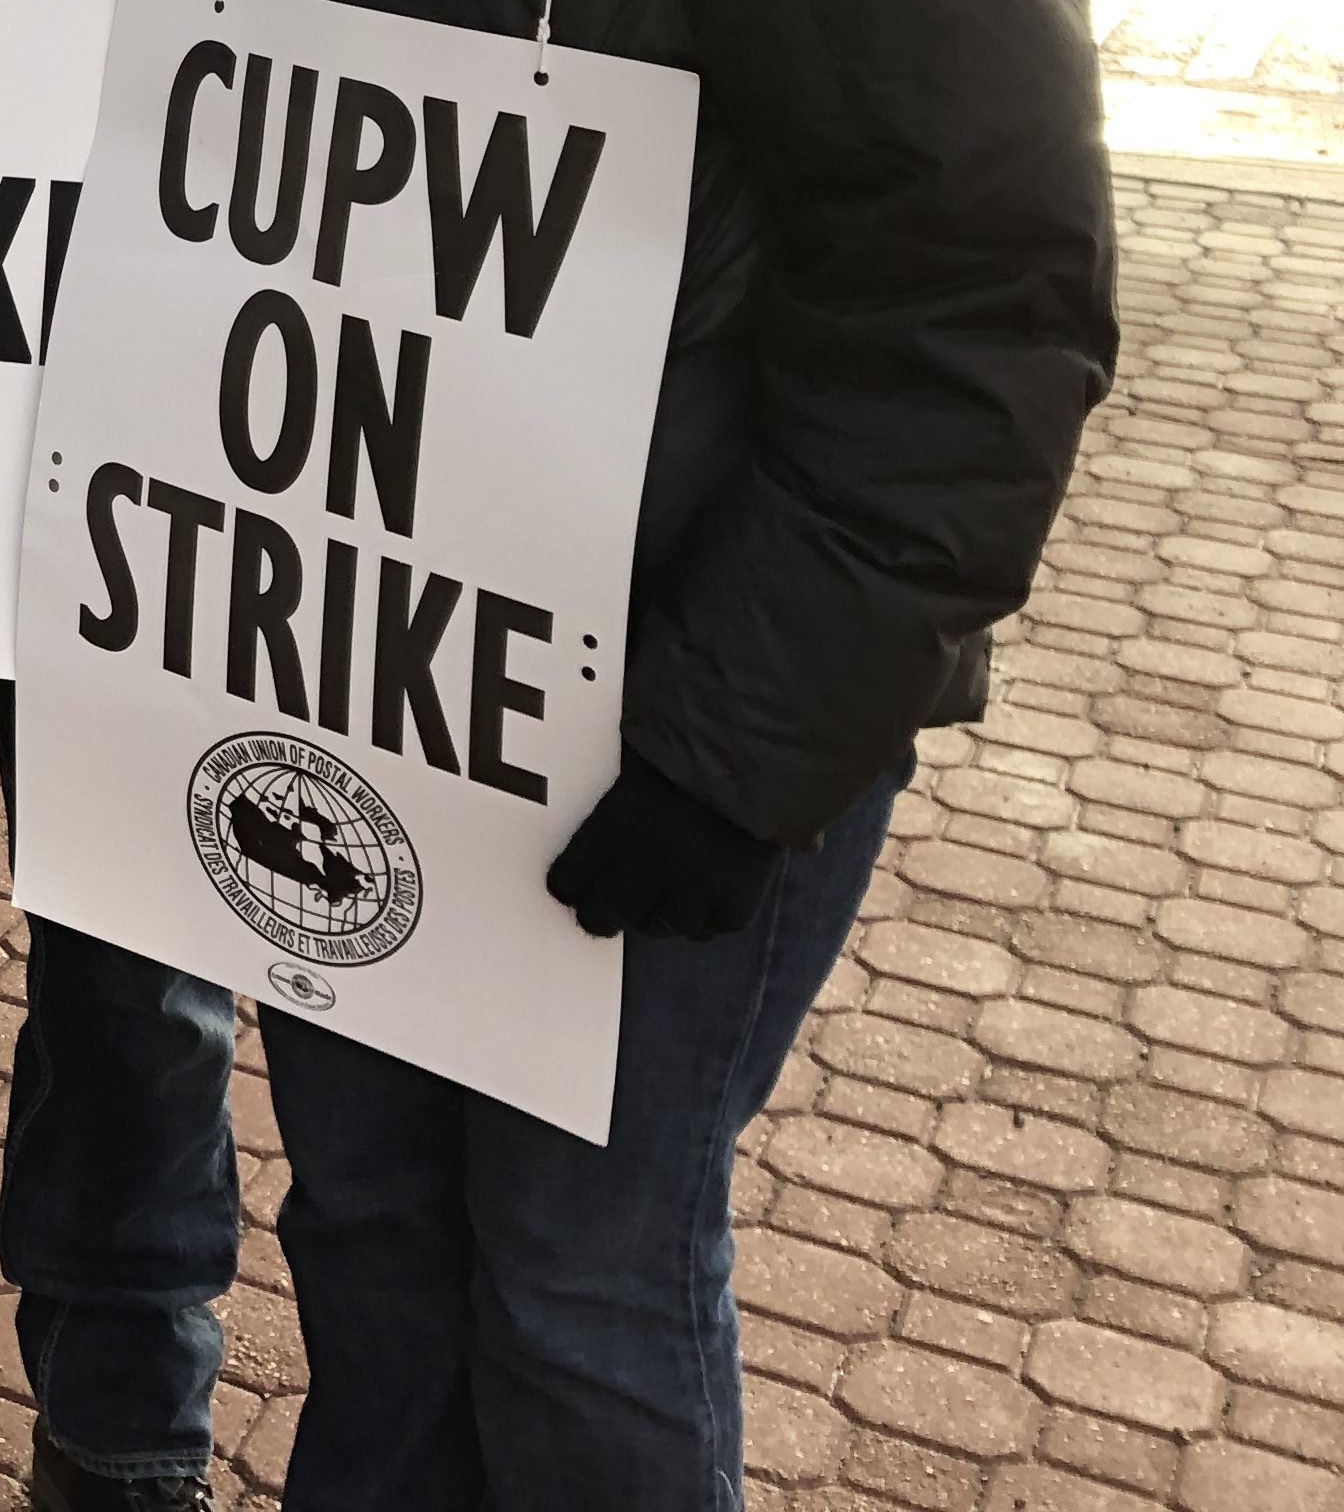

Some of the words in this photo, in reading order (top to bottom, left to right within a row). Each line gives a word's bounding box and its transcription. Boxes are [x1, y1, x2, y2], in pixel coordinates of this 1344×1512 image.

[158, 39, 607, 340] CUPW
[219, 289, 432, 539] ON
[78, 462, 554, 807] STRIKE
[193, 793, 216, 855] SYNDICAT
[202, 740, 252, 784] CANADIAN
[251, 739, 287, 763] UNION
[289, 744, 307, 765] OF
[307, 750, 355, 794] POSTAL
[350, 785, 405, 847] WORKERS
[203, 852, 229, 877] DES
[392, 867, 416, 913] POSTES
[219, 871, 296, 949] TRAVAILLEURS
[383, 907, 411, 935] DES
[297, 934, 312, 955] ET
[313, 923, 398, 961] TRAVAILLEUSES
